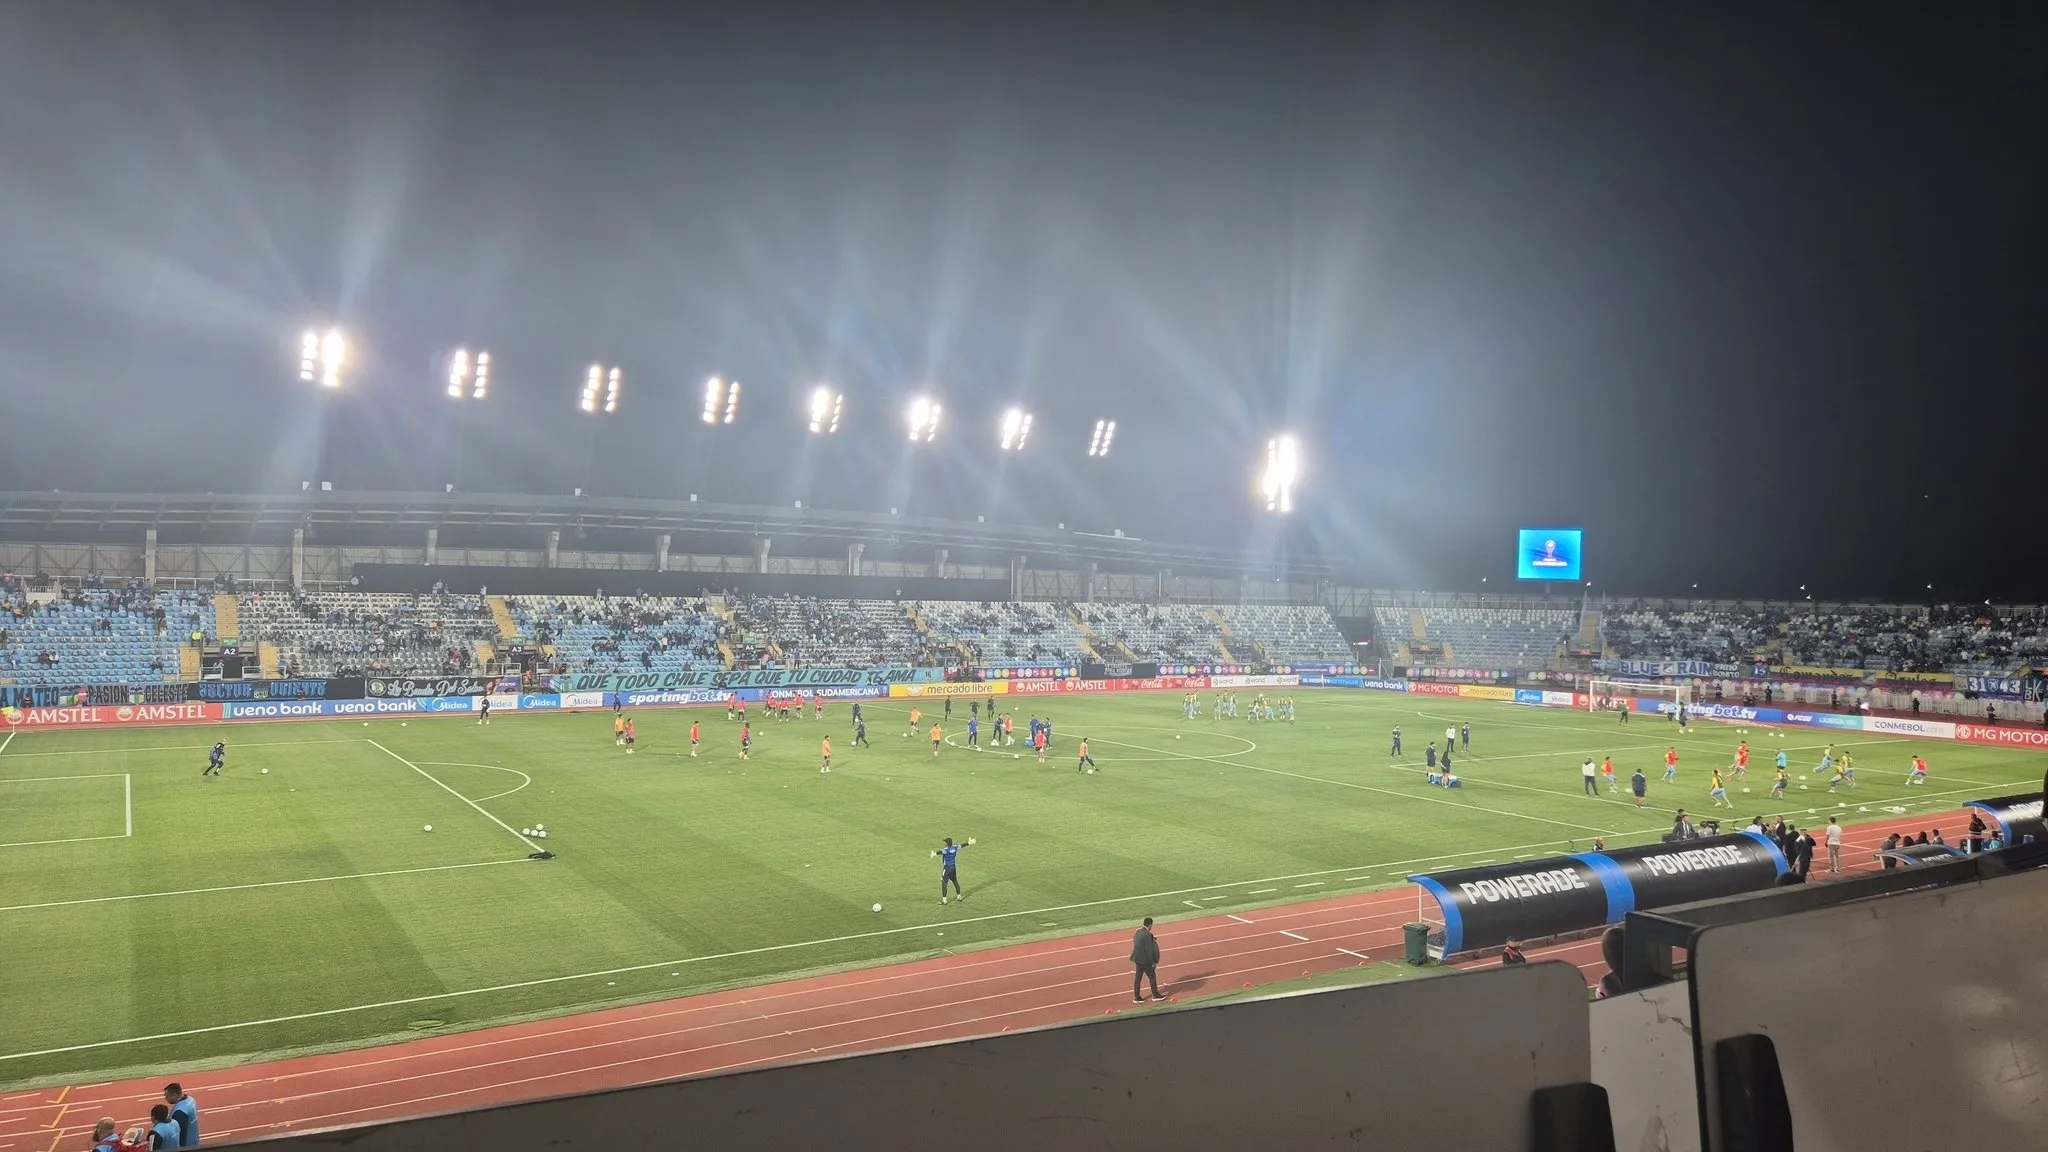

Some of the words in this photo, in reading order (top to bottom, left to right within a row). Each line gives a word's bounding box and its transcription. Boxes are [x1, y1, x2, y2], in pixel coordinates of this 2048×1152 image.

[1620, 660, 1660, 675] BLUE
[1677, 661, 1712, 676] RAIN
[576, 674, 612, 690] QUE
[615, 673, 660, 691] TODO
[663, 672, 709, 687] CHILE
[710, 670, 752, 686] SEPA
[755, 670, 785, 685] QUE
[787, 669, 809, 683] TU
[809, 669, 863, 683] CIUDAD
[884, 669, 917, 682] AMA
[1025, 681, 1060, 692] AMSTEL
[1075, 680, 1107, 690] AMSTEL
[1364, 680, 1383, 688] ueno
[1383, 680, 1403, 690] bank
[1969, 677, 1987, 692] 31
[2000, 679, 2020, 693] 43
[87, 685, 128, 704] PASION
[145, 684, 188, 703] CELESTE
[816, 687, 880, 697] SUDAMERICANA
[927, 684, 970, 694] mercado
[972, 683, 993, 693] libre
[1417, 684, 1430, 692] MG
[1430, 684, 1459, 694] MOTOR
[530, 698, 557, 707] Midea
[573, 697, 598, 705] Midea
[627, 690, 732, 705] sportingbet.tv
[233, 705, 278, 716] ueno
[280, 701, 321, 715] bank
[335, 702, 375, 713] ueno
[377, 699, 417, 711] bank
[439, 701, 468, 709] Midea
[26, 707, 102, 724] AMSTEL
[136, 705, 206, 720] AMSTEL
[1974, 728, 1997, 740] MG
[1642, 844, 1749, 877] POWERADE
[1459, 867, 1587, 904] POWERADE
